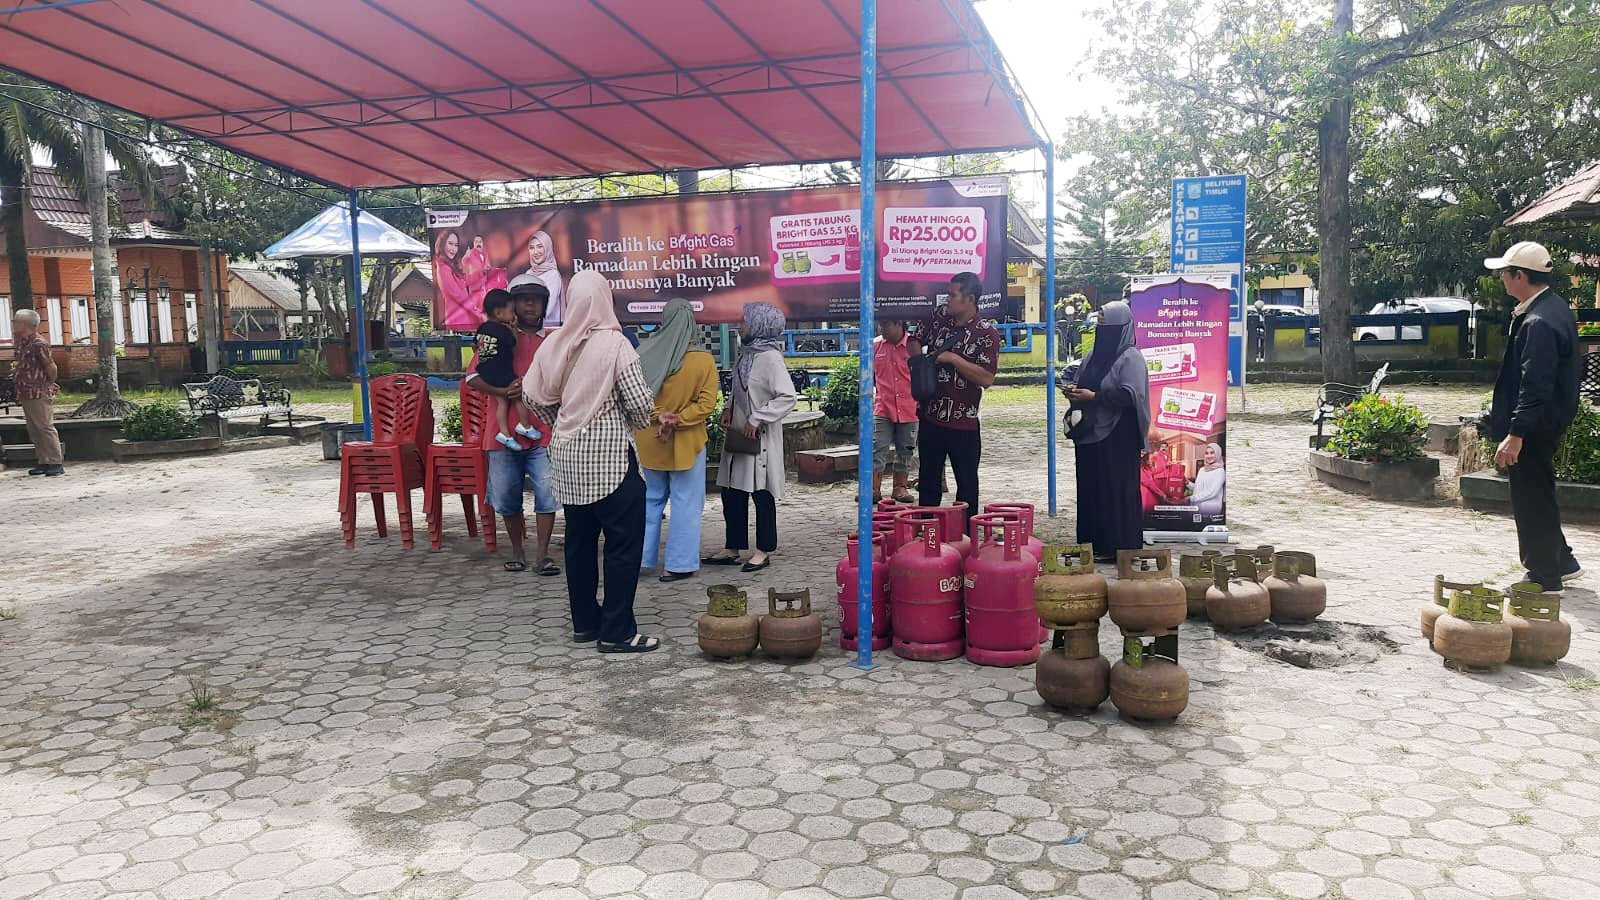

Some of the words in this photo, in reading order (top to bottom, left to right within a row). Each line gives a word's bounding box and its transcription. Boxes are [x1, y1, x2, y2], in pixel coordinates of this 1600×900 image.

[781, 218, 812, 228] GRATIS
[813, 215, 851, 226] TABUNG
[776, 230, 807, 239] BRIGHT
[810, 228, 828, 236] GAS
[830, 226, 842, 236] 5,5
[844, 225, 858, 234] KG
[889, 226, 977, 244] Rp25.000
[587, 236, 643, 254] Beralih
[647, 236, 665, 251] ke
[669, 234, 707, 250] Bright
[710, 234, 734, 248] Gas
[573, 256, 648, 273] Ramadan
[652, 254, 696, 271] Lebih
[701, 252, 761, 272] Ringan
[606, 275, 672, 293] onusnya
[677, 272, 736, 291] Banyak
[1158, 308, 1180, 318] Bright
[1196, 320, 1222, 328] Ringan
[1148, 331, 1183, 339] Bonusnya
[1185, 330, 1211, 339] Banyak
